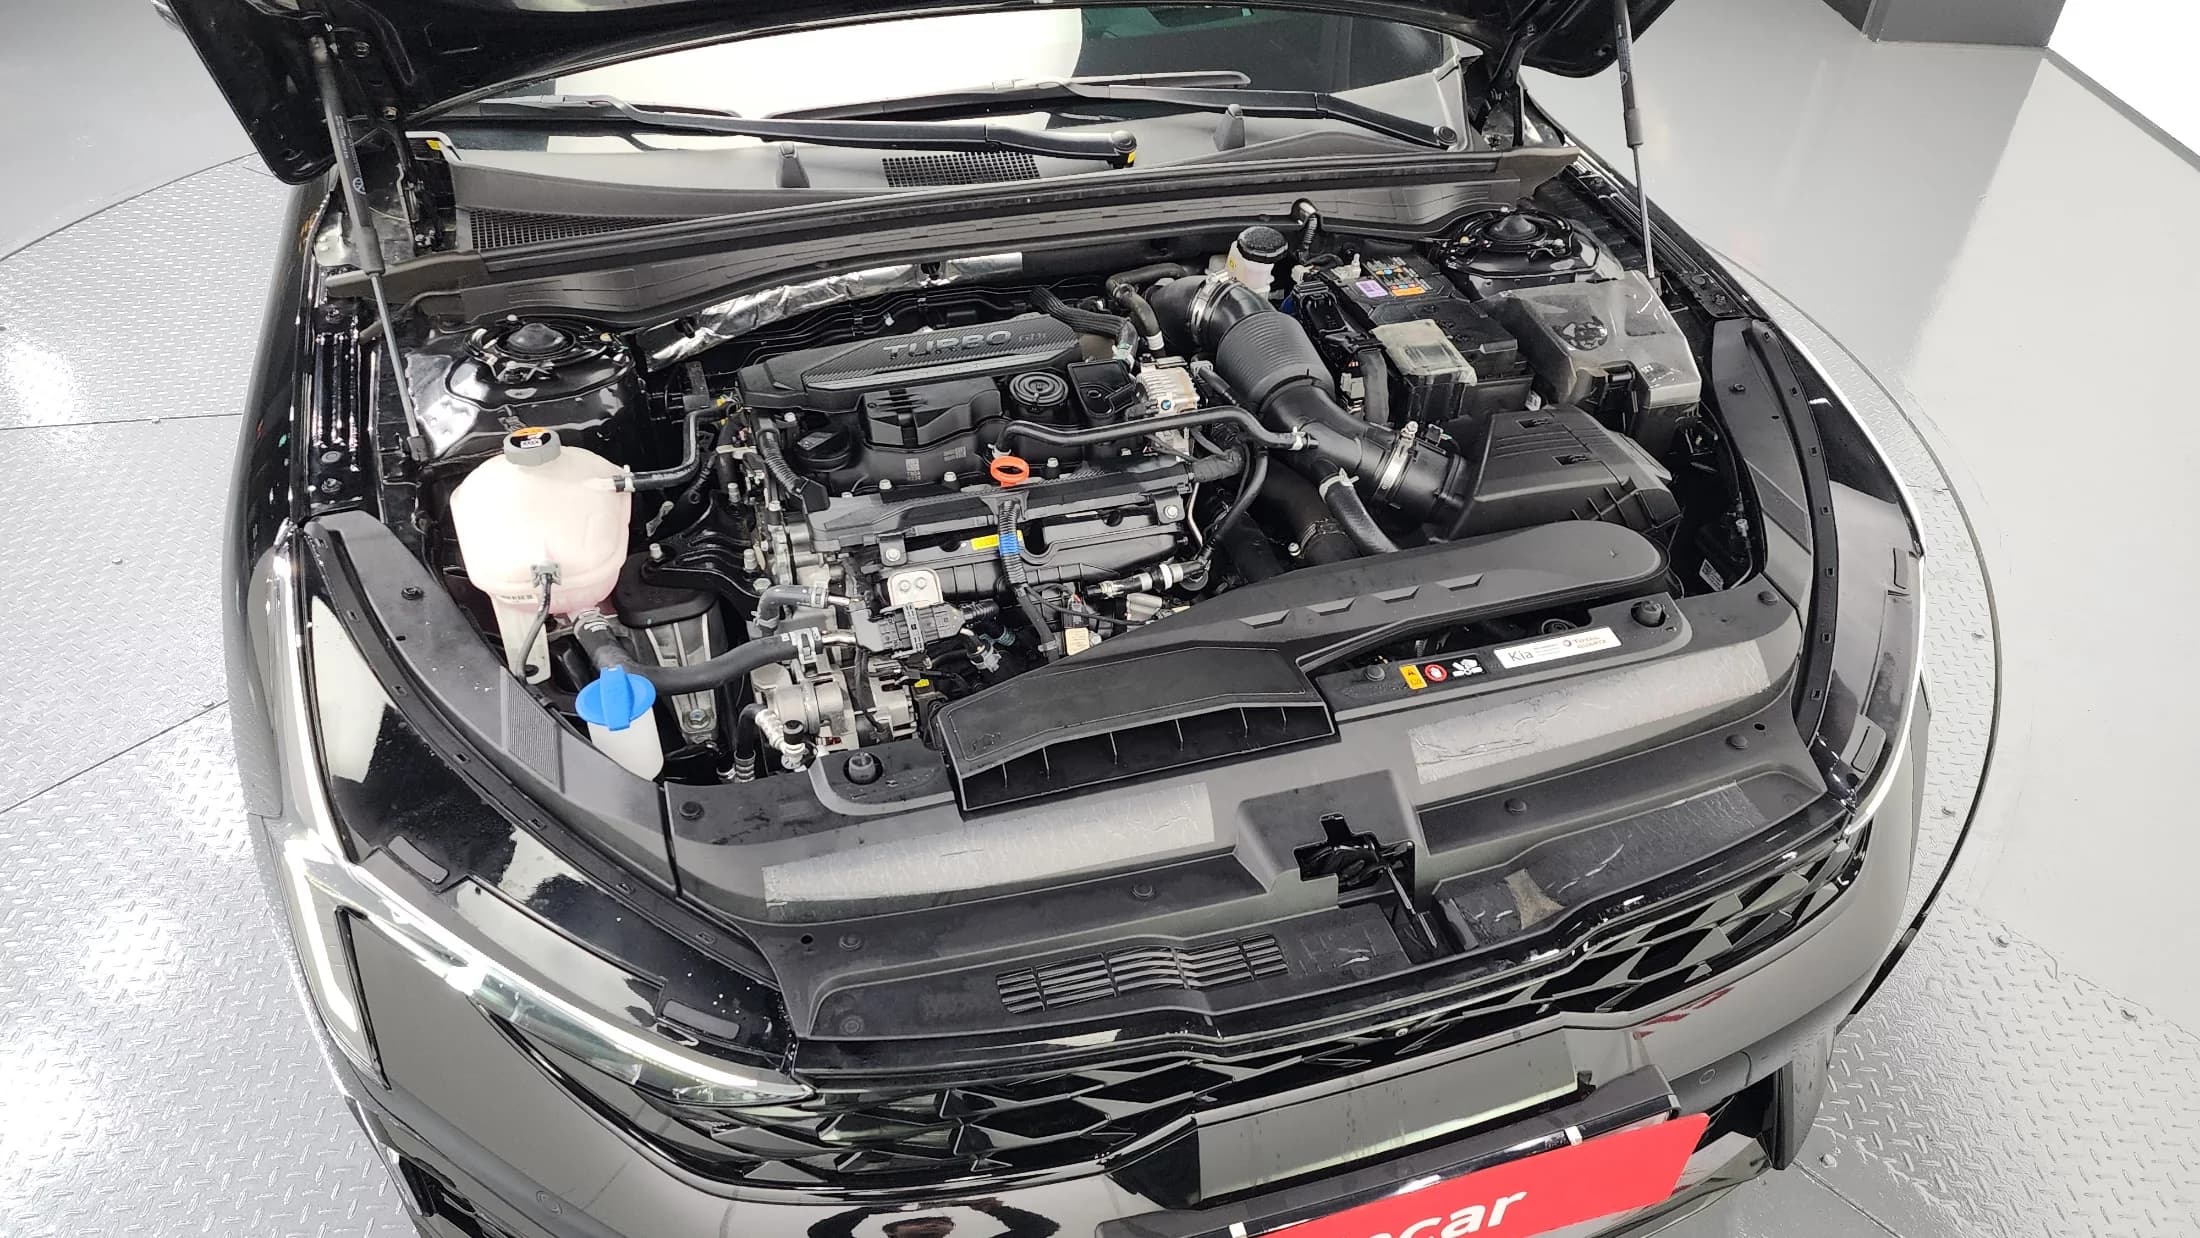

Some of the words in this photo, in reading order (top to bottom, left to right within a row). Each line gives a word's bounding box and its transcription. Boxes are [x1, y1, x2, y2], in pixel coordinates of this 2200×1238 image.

[883, 330, 1012, 360] TURBO
[1508, 648, 1534, 663] Kia
[1370, 1191, 1527, 1238] car
